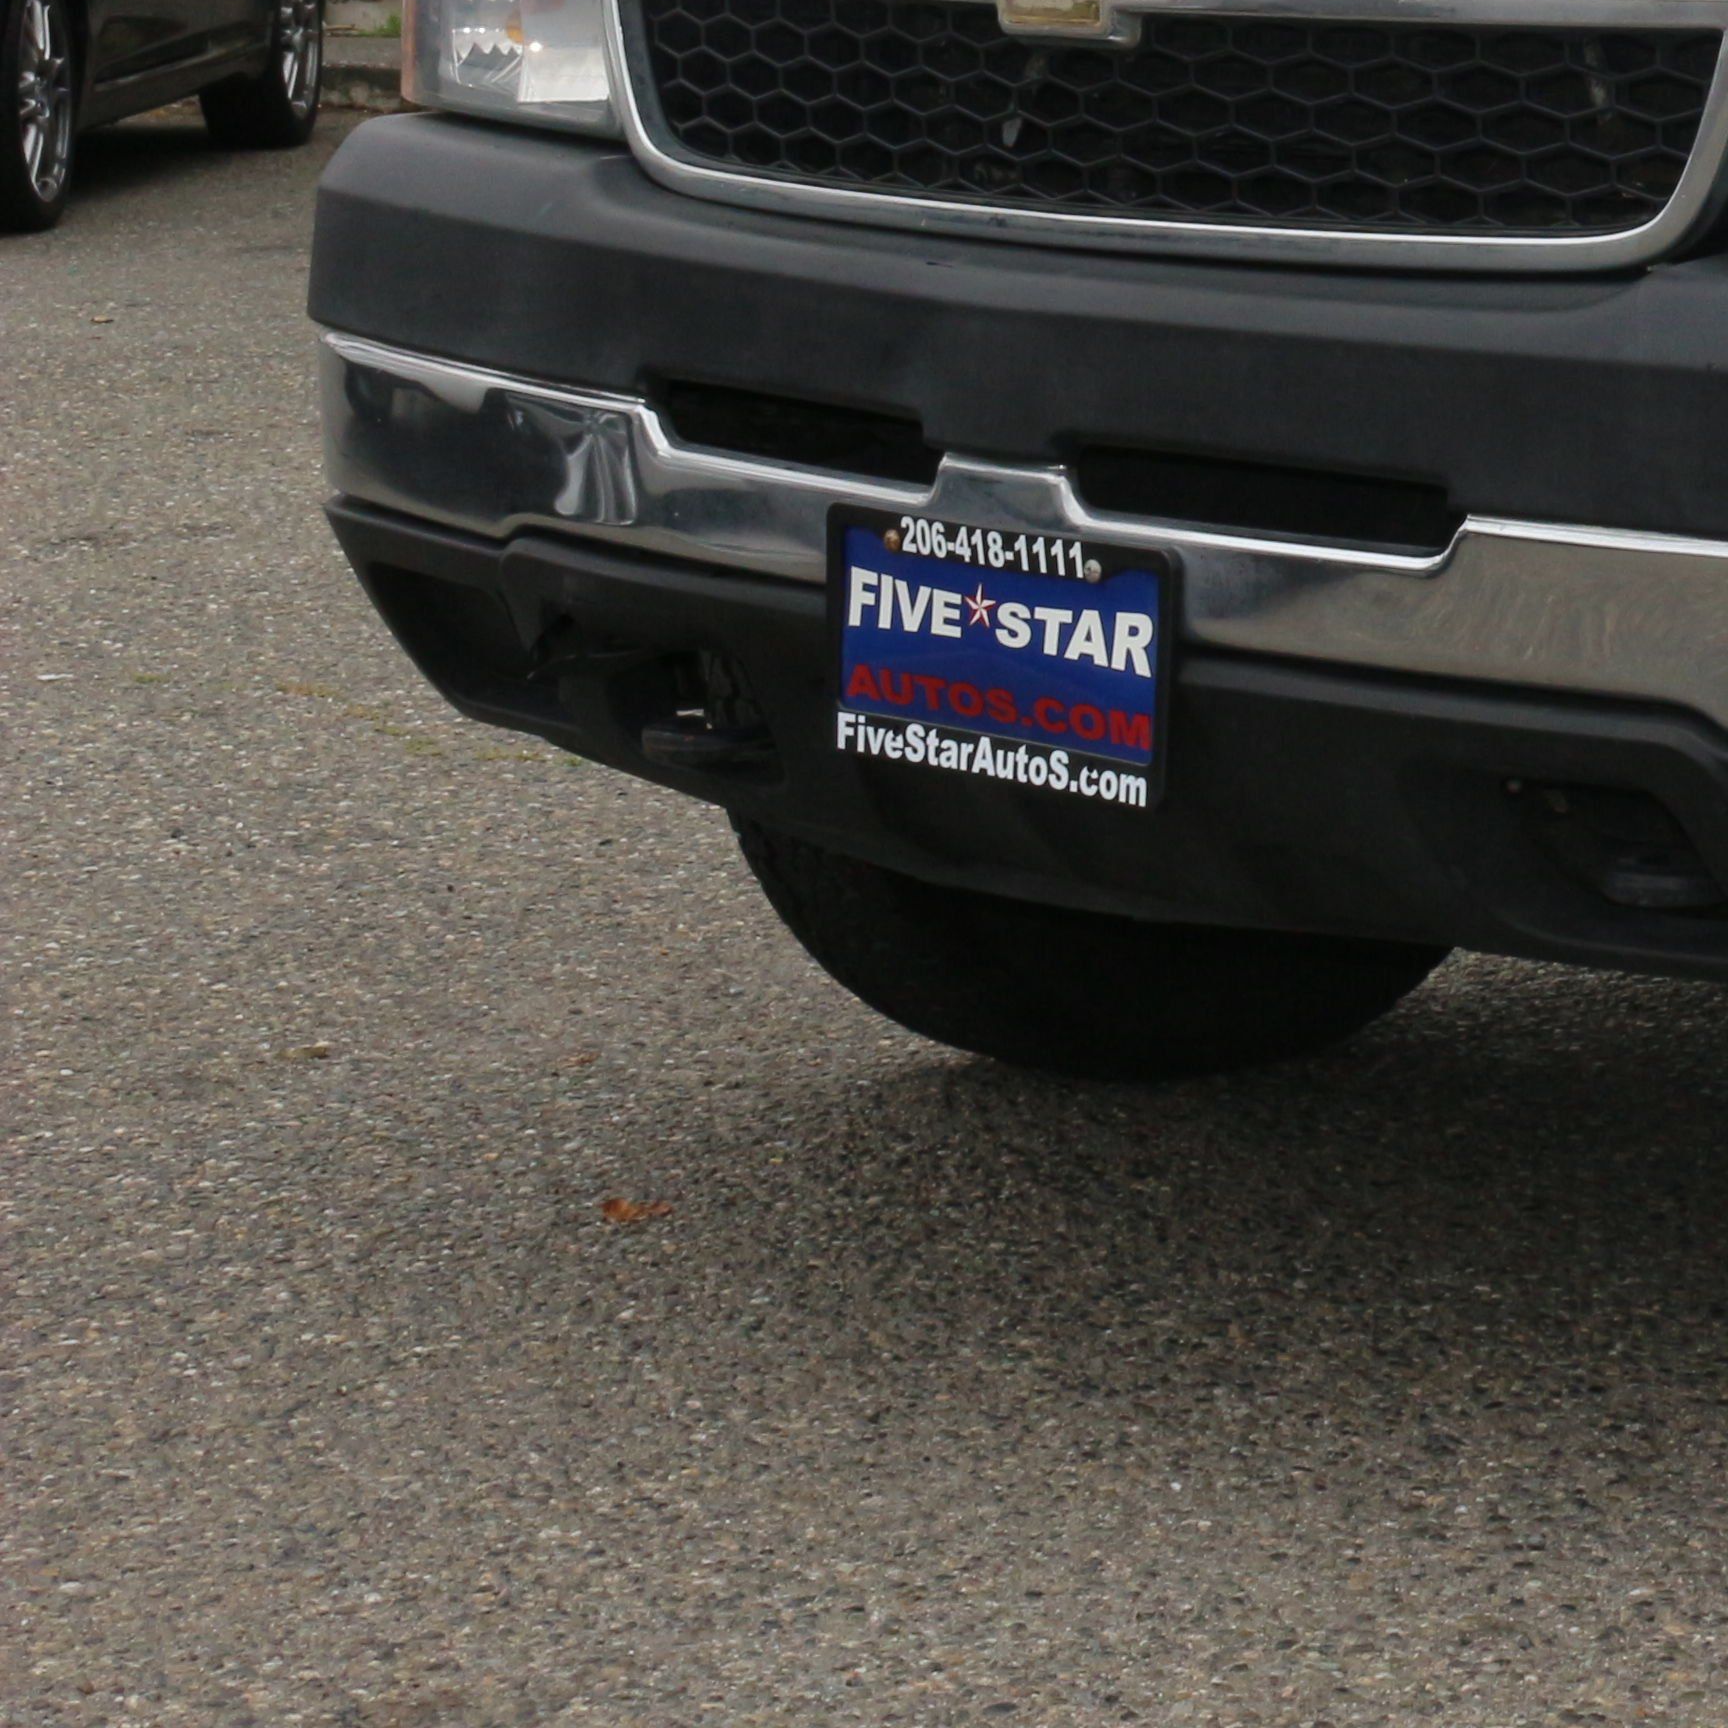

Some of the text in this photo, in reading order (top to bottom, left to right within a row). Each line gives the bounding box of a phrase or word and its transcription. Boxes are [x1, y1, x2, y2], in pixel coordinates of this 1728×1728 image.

[900, 516, 1084, 579] 206-418-1111
[847, 565, 1154, 679] FIVE STAR
[847, 663, 1152, 751] AUTOS.COM
[836, 711, 1148, 808] FiveStarAutoS.com
